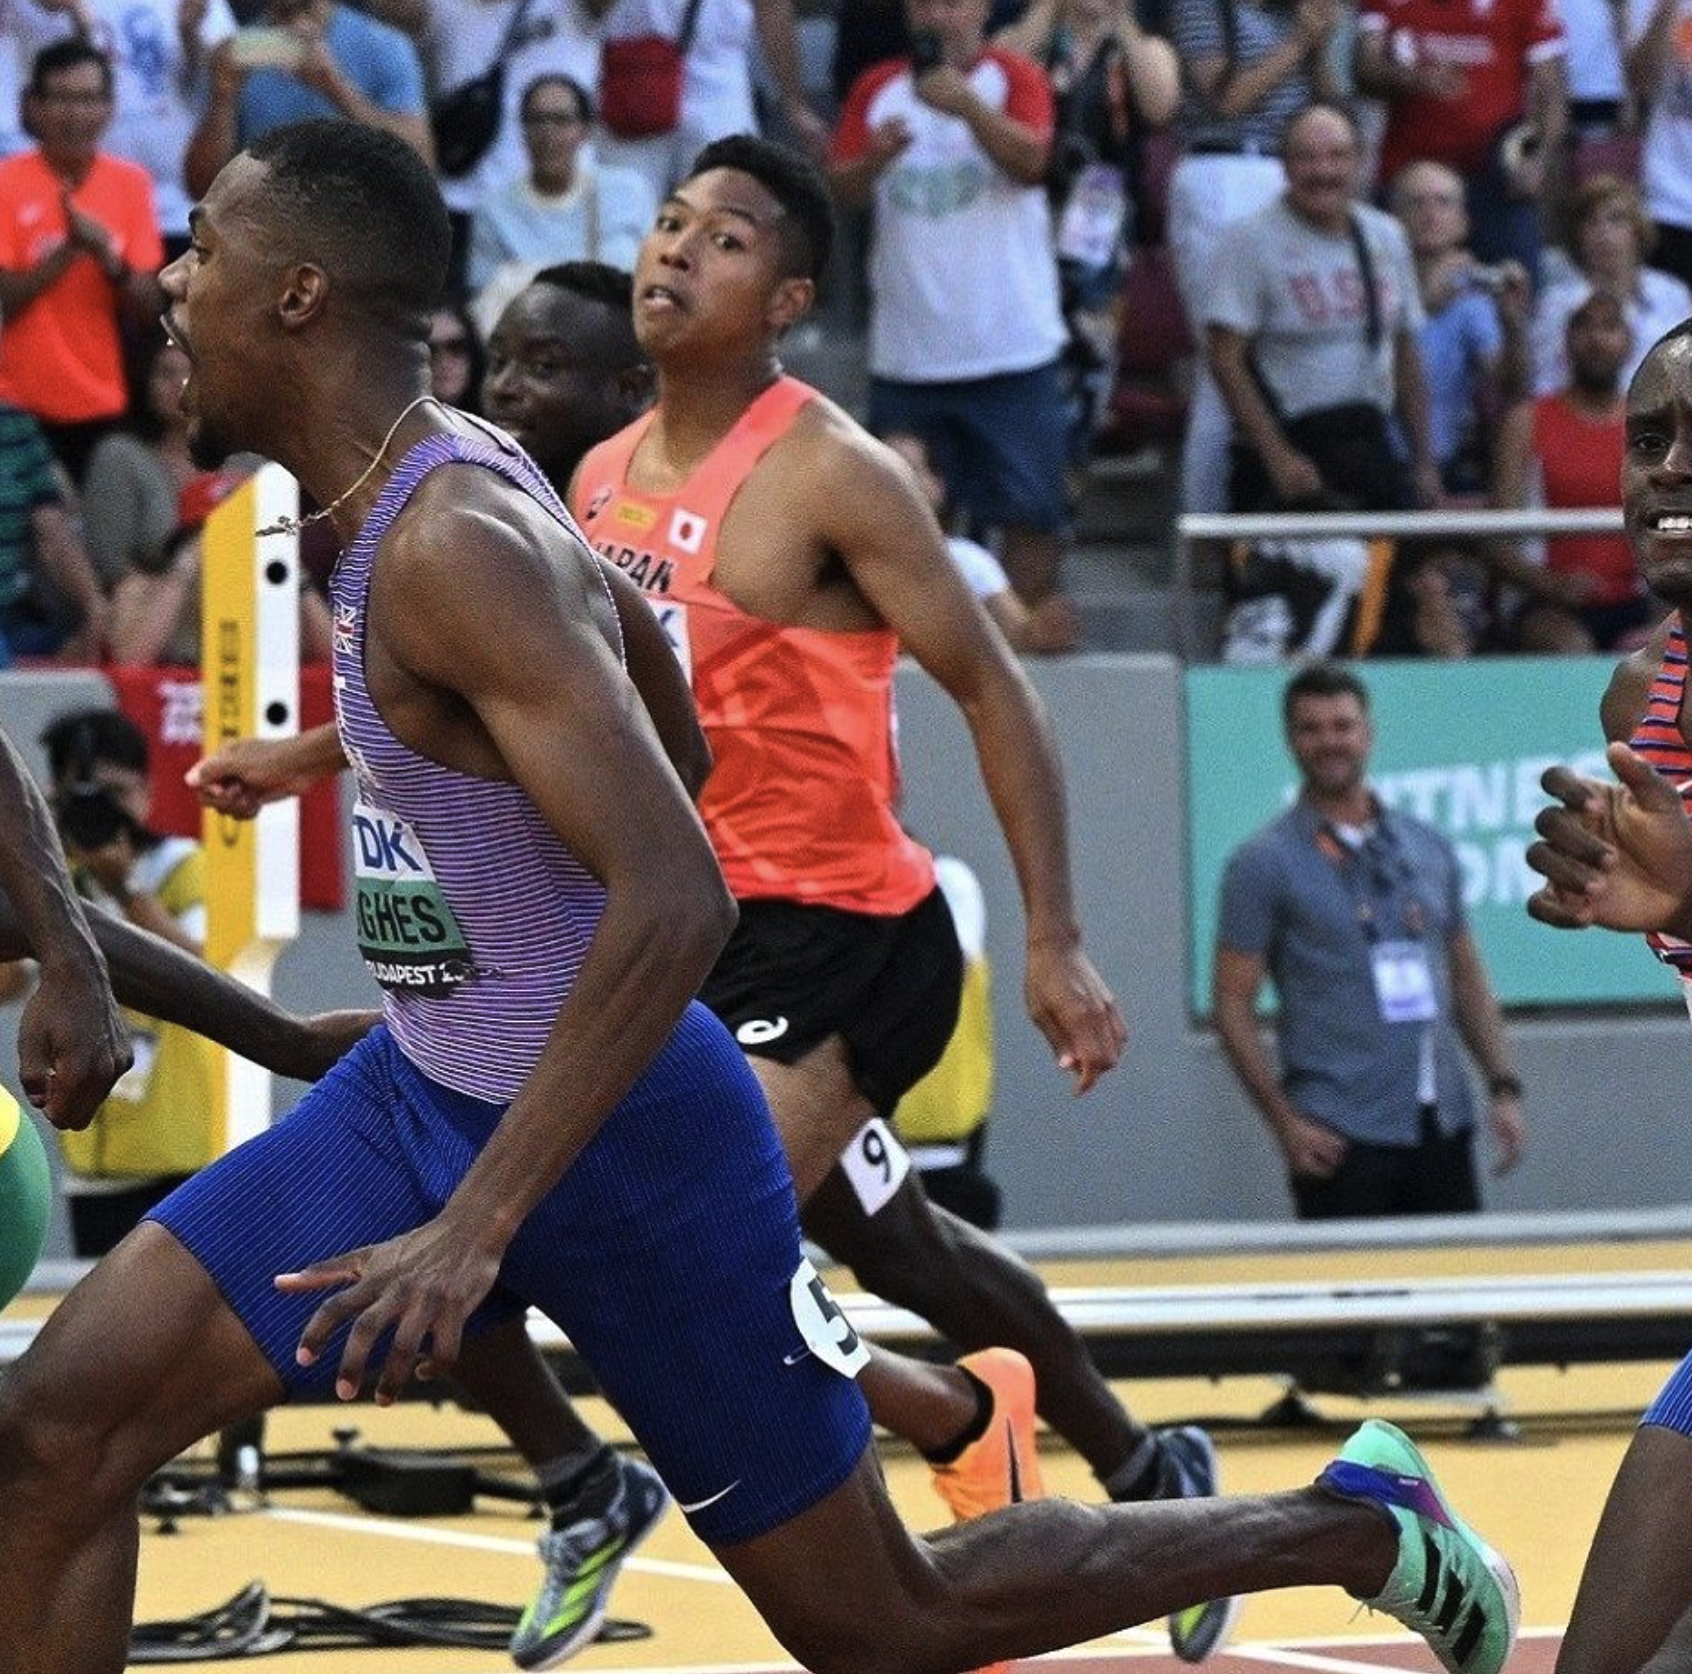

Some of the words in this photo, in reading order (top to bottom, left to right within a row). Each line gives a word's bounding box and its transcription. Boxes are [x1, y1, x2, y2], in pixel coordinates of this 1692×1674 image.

[597, 542, 673, 593] PAN
[350, 813, 423, 871] DK
[357, 889, 448, 945] GHES
[862, 1128, 891, 1184] 9
[807, 1274, 860, 1357] 5
